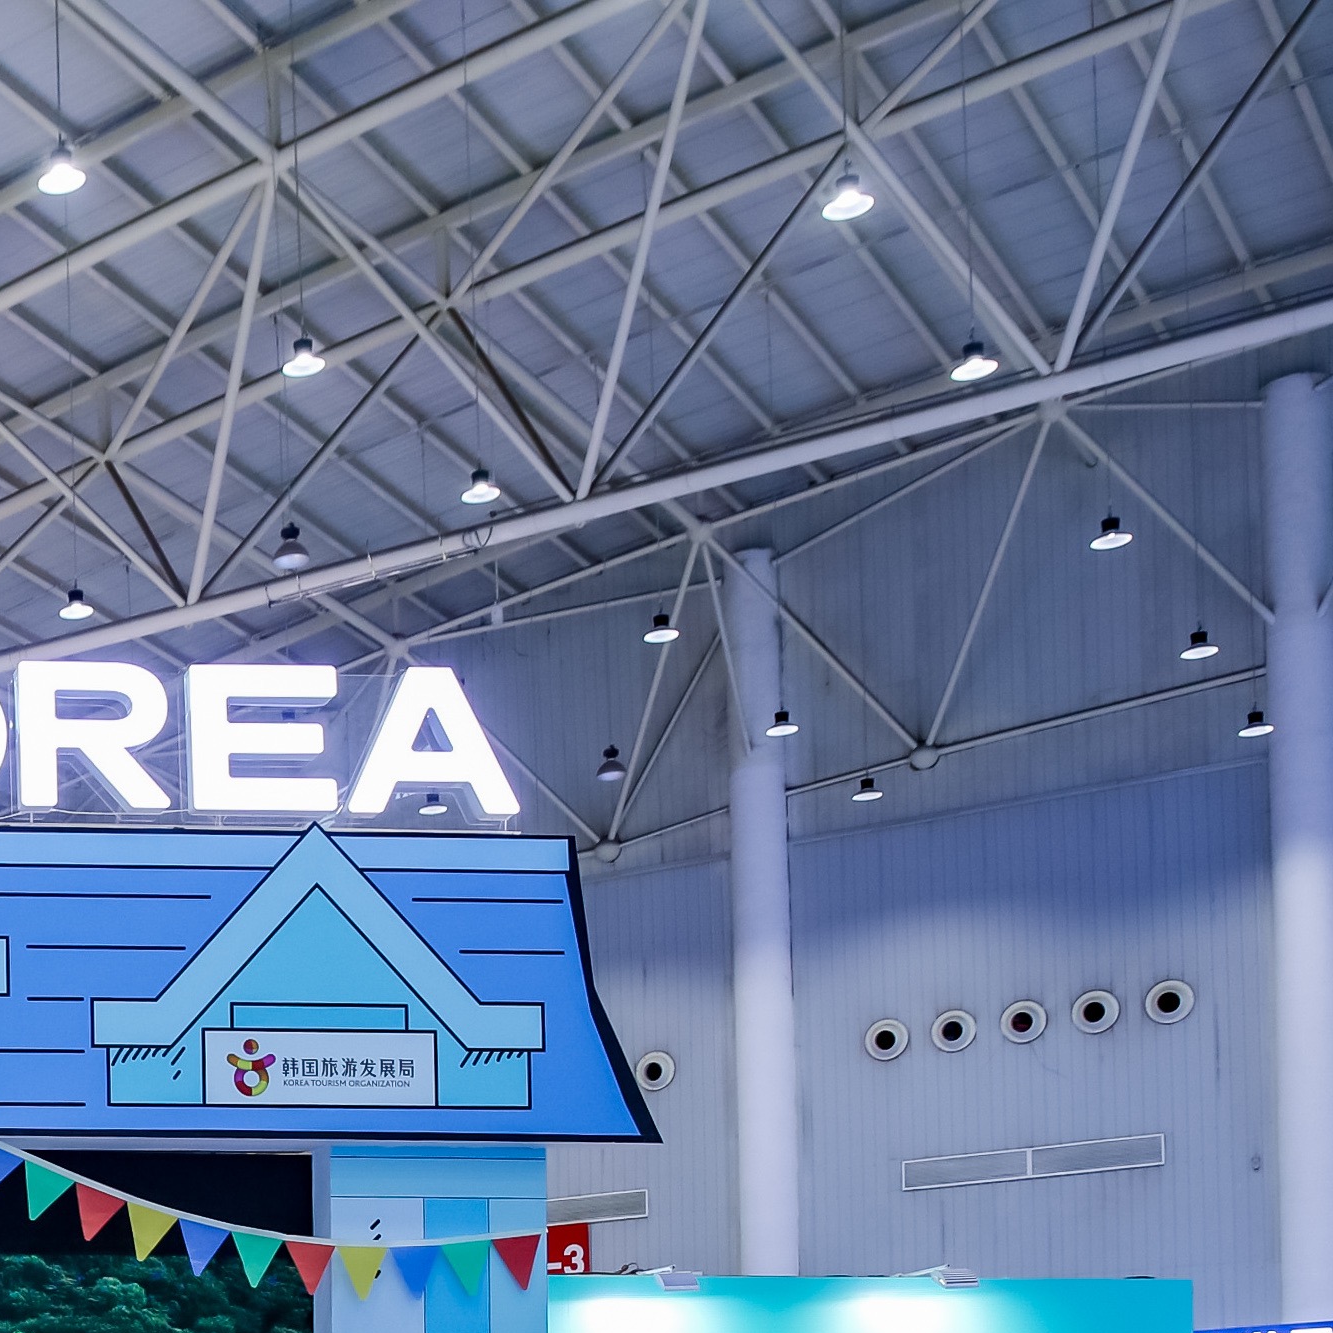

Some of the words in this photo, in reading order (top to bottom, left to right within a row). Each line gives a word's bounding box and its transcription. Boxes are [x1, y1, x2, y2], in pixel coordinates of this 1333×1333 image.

[281, 1057, 416, 1079] 韩国旅游发展局
[282, 1079, 310, 1087] KOREA
[311, 1079, 347, 1087] TOURISM
[348, 1079, 411, 1088] ORGANIZATION
